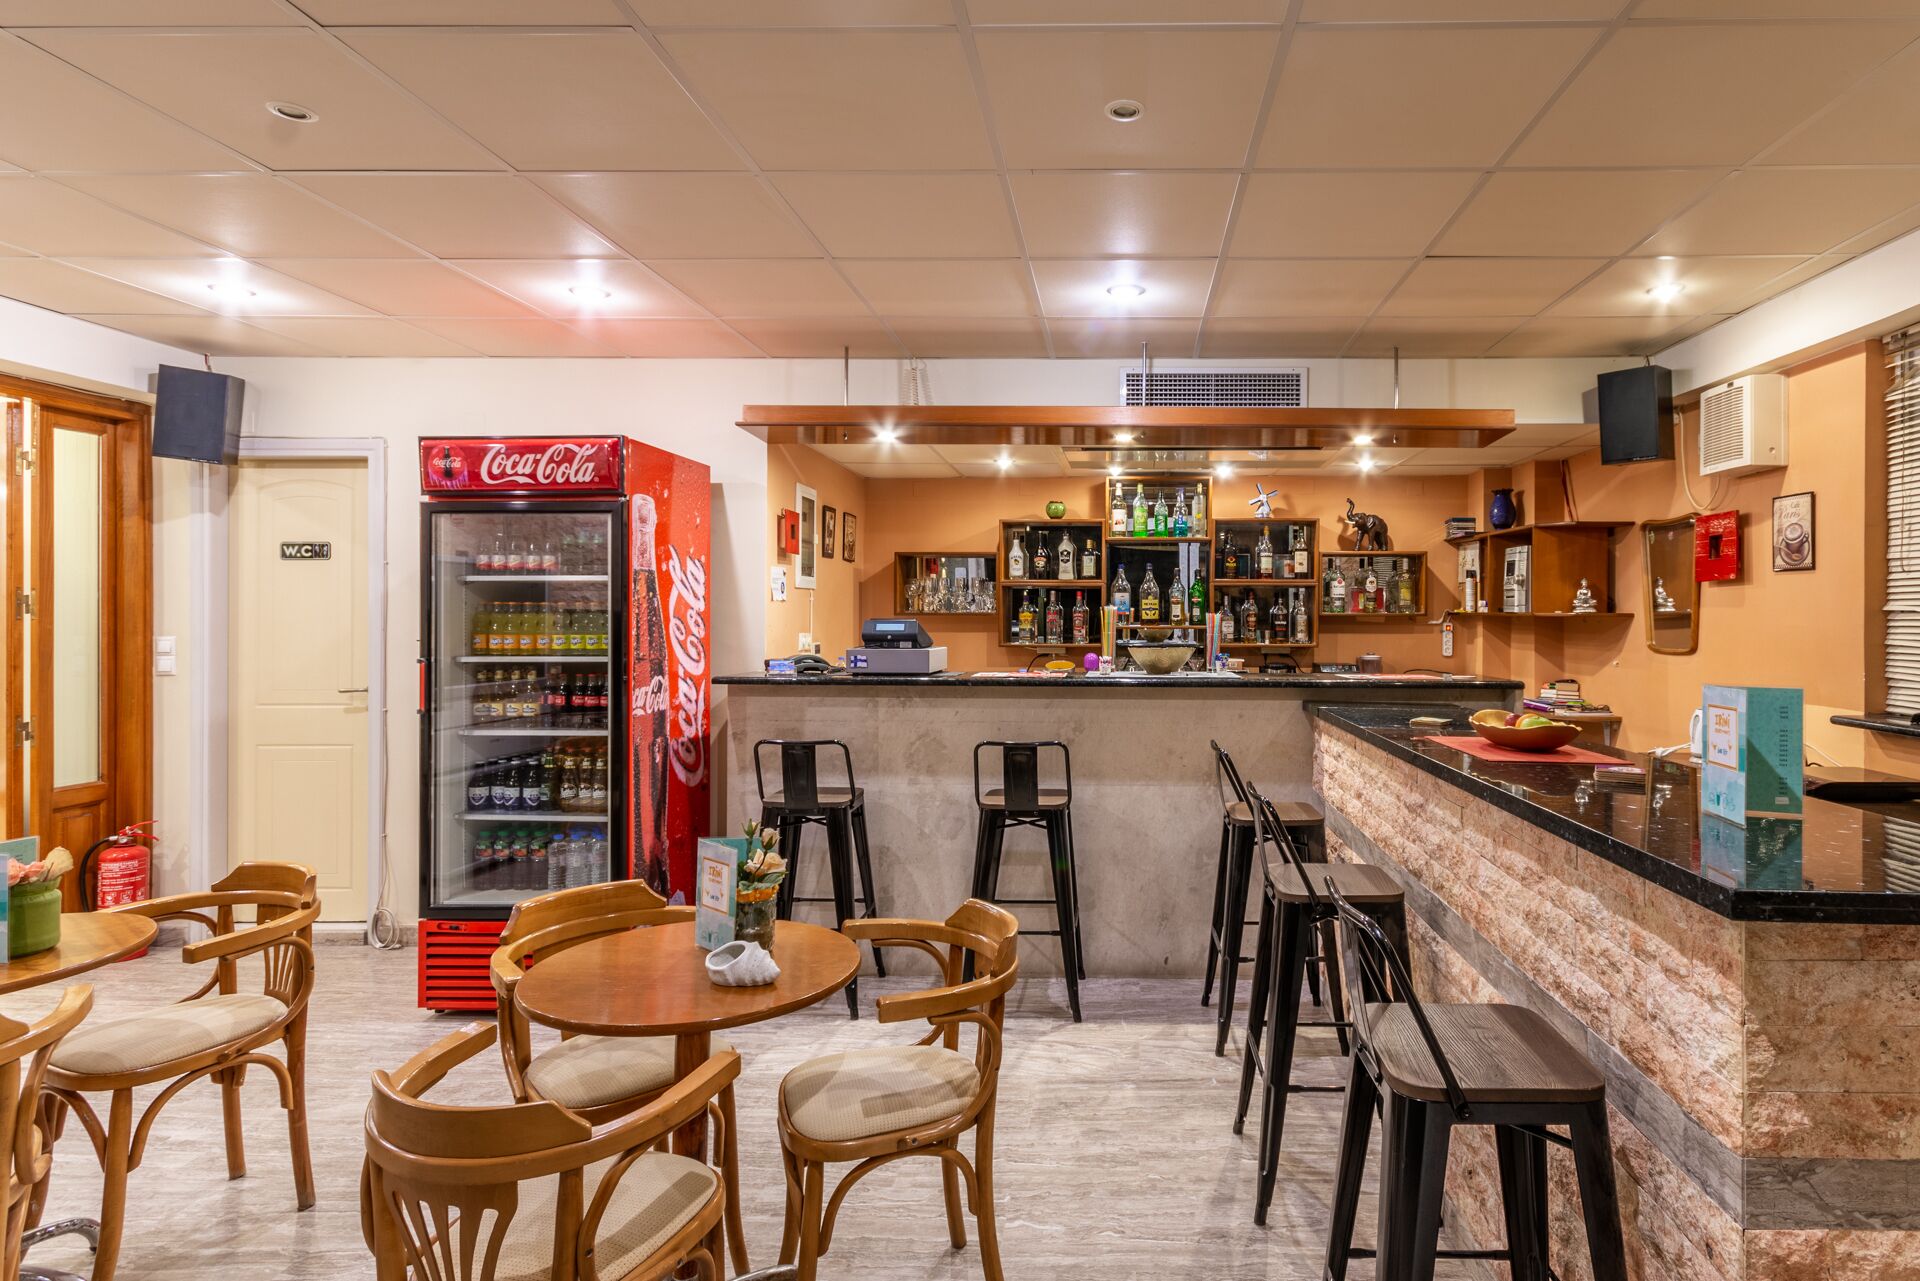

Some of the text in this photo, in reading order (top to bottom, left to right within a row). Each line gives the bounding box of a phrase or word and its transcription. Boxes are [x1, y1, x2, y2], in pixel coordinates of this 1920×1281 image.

[480, 443, 599, 484] Coca-Cola
[282, 545, 313, 557] W.C
[669, 544, 706, 787] Coca-Cola
